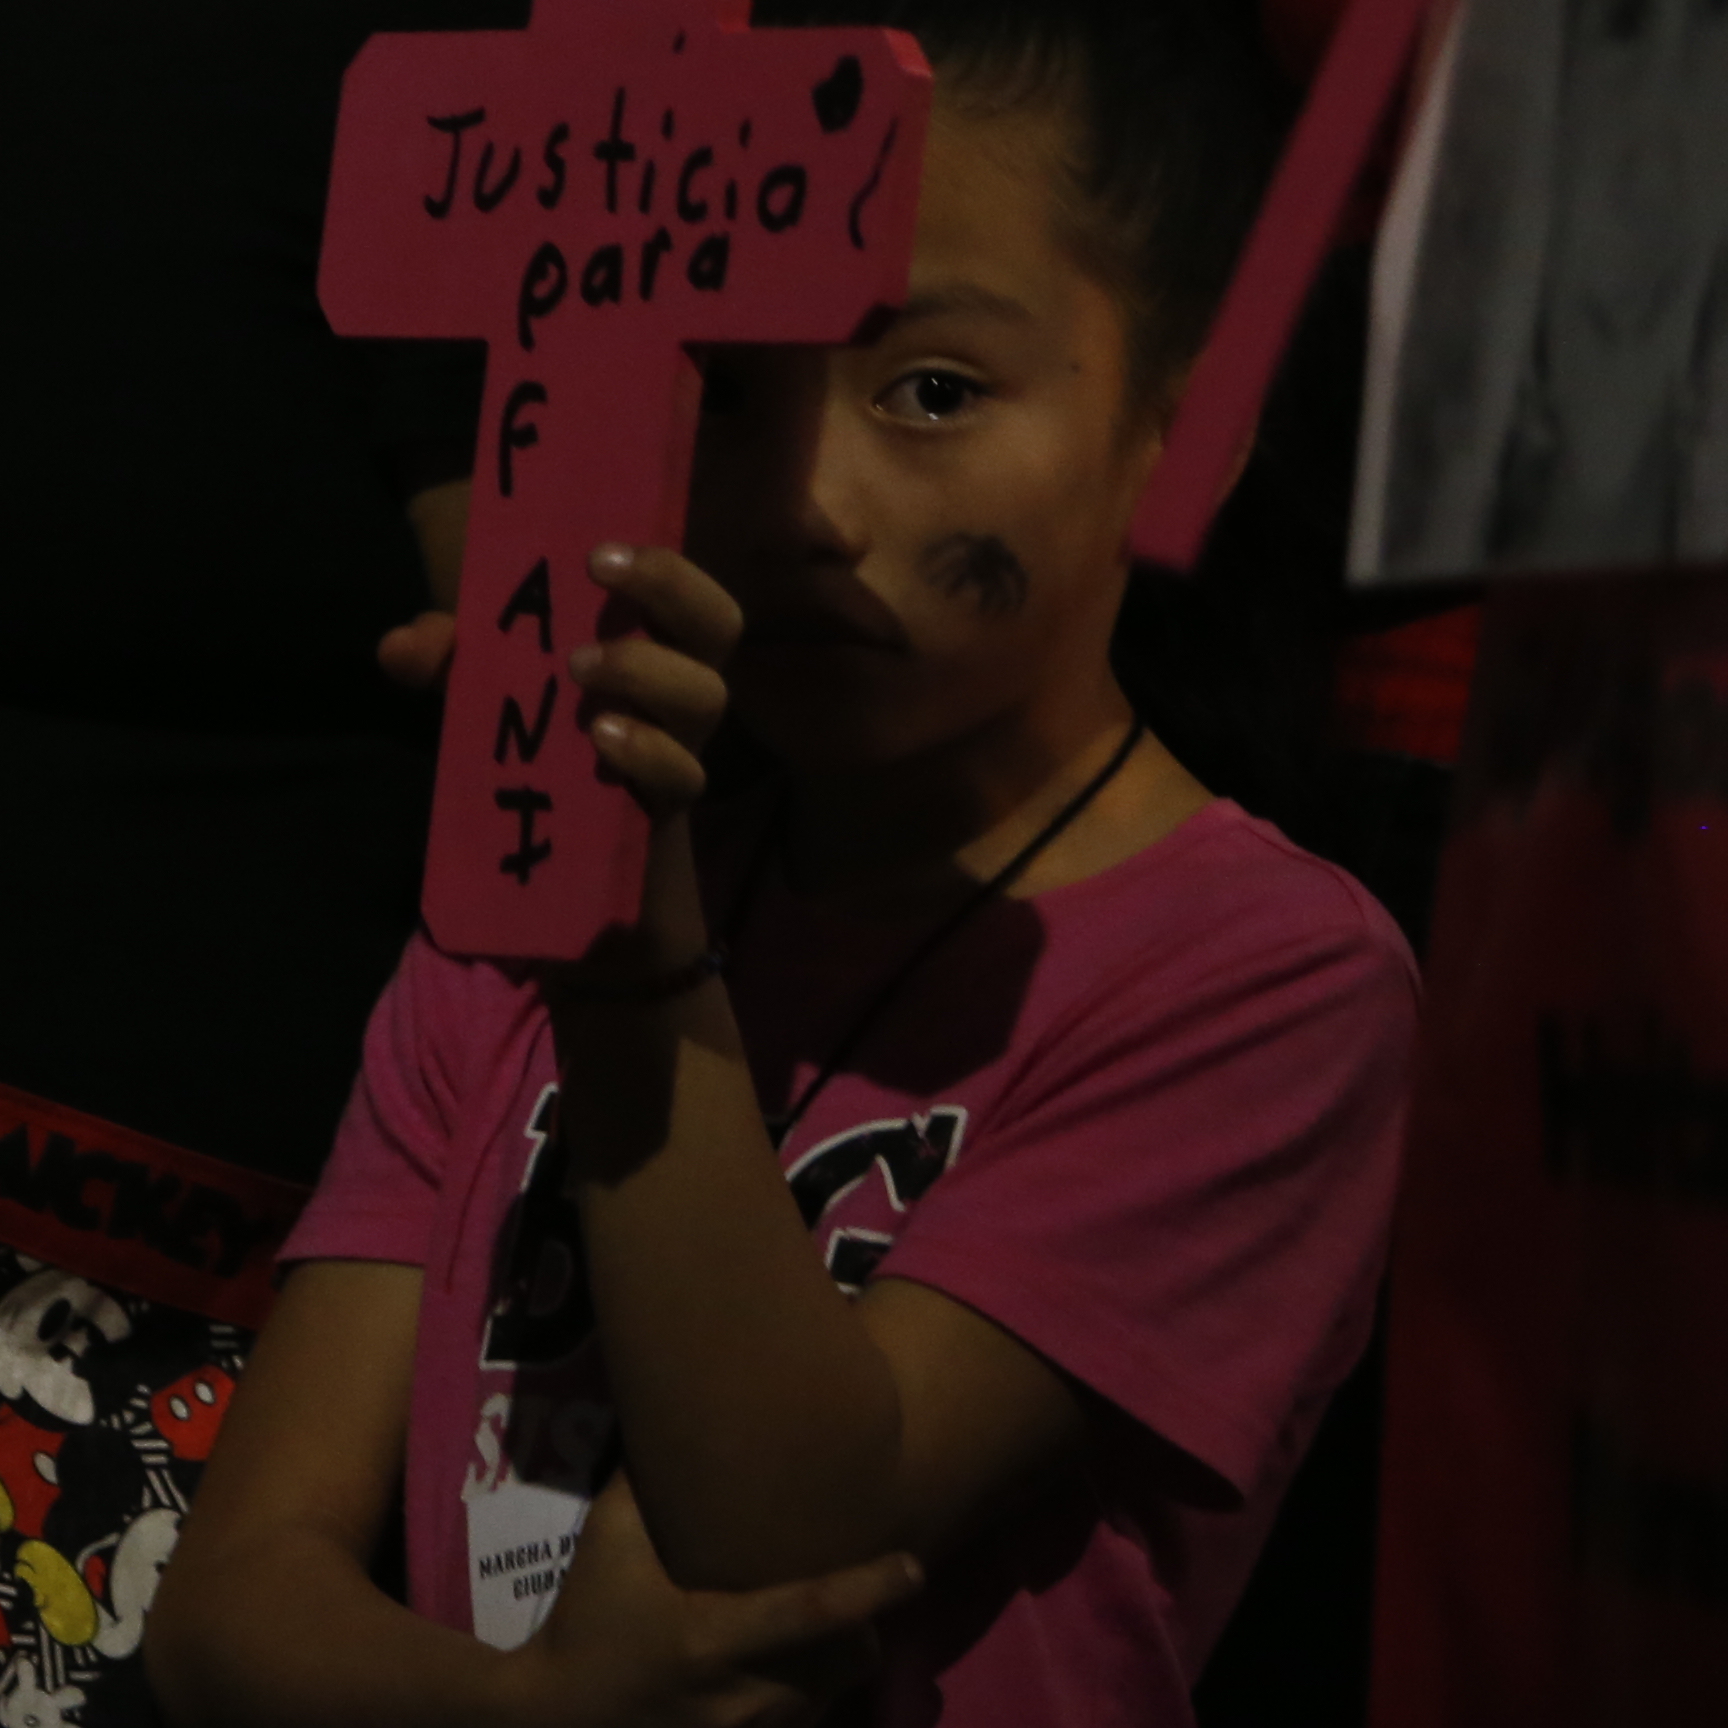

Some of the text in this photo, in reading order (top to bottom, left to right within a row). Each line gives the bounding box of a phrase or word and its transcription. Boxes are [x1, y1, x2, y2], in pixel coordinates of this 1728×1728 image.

[519, 227, 729, 351] para
[493, 381, 557, 885] FANI
[478, 1538, 552, 1580] MARCHA
